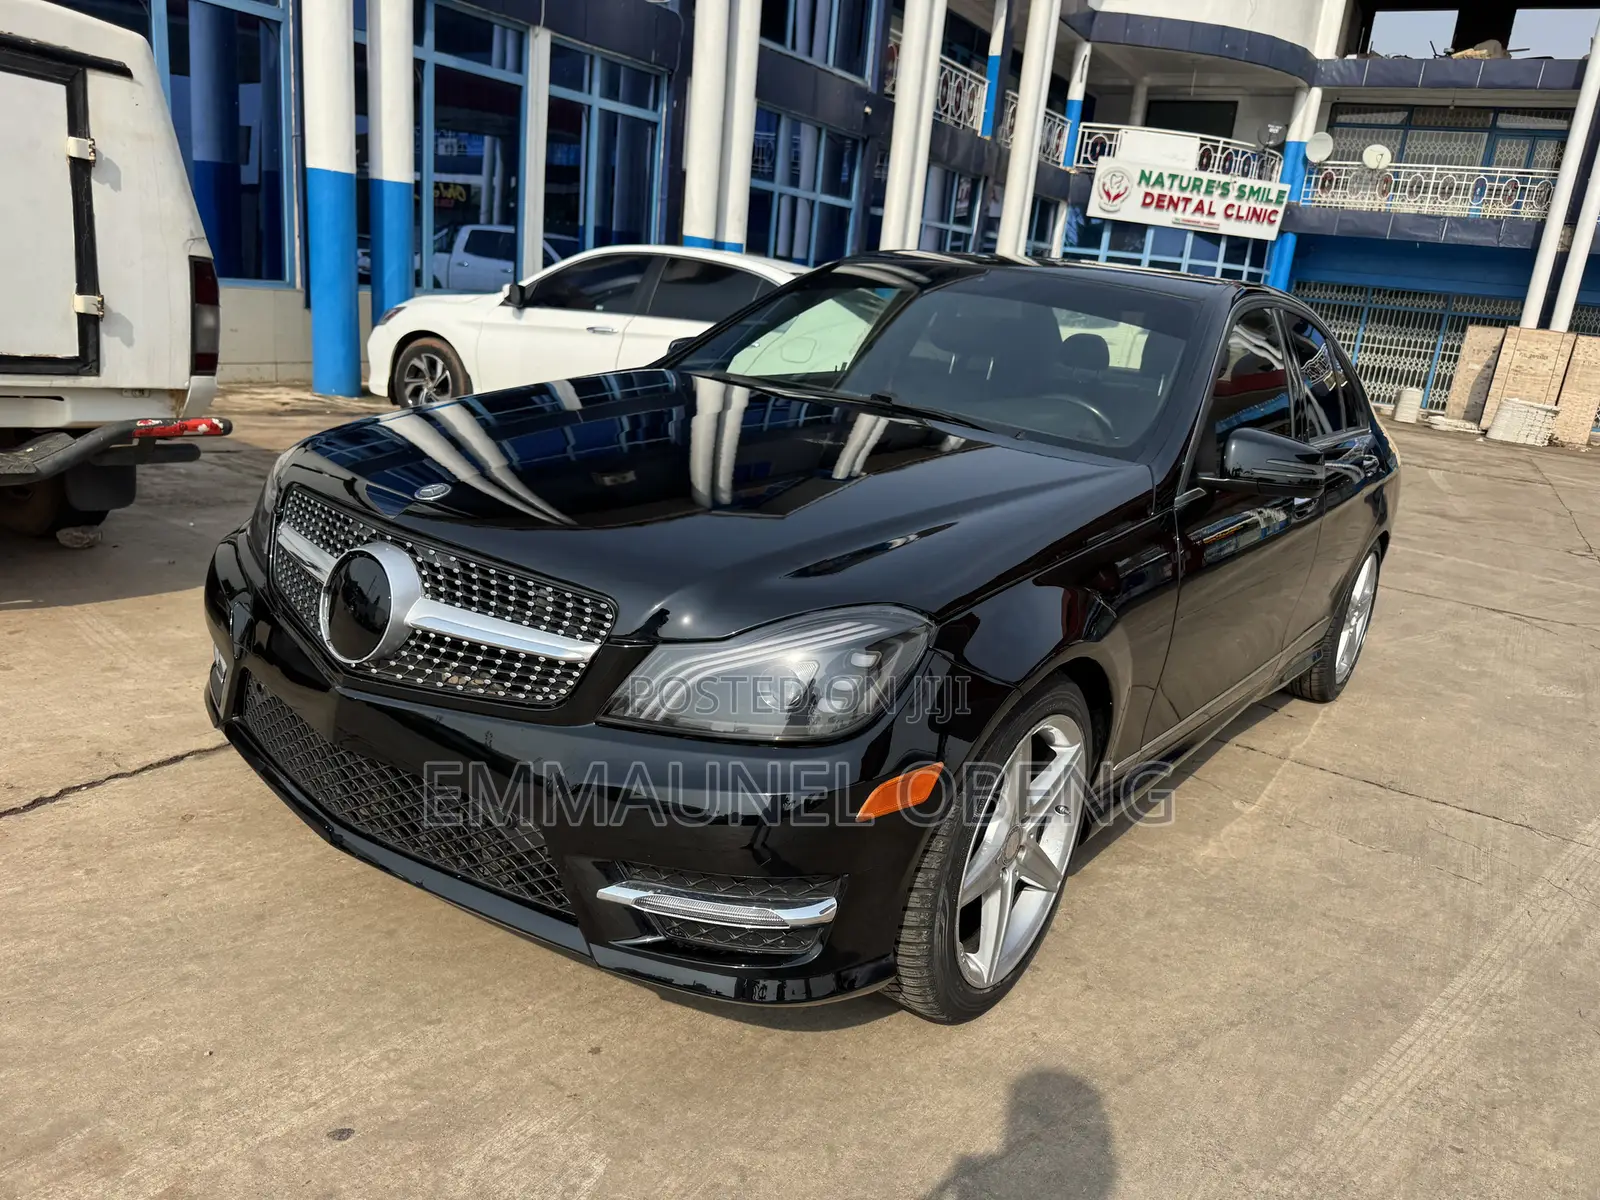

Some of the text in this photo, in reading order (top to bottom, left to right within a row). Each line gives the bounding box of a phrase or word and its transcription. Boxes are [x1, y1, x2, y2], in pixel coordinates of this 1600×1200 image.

[1138, 169, 1288, 205] NATURE'S SMILE
[1141, 191, 1280, 224] DENTAL CLINIC
